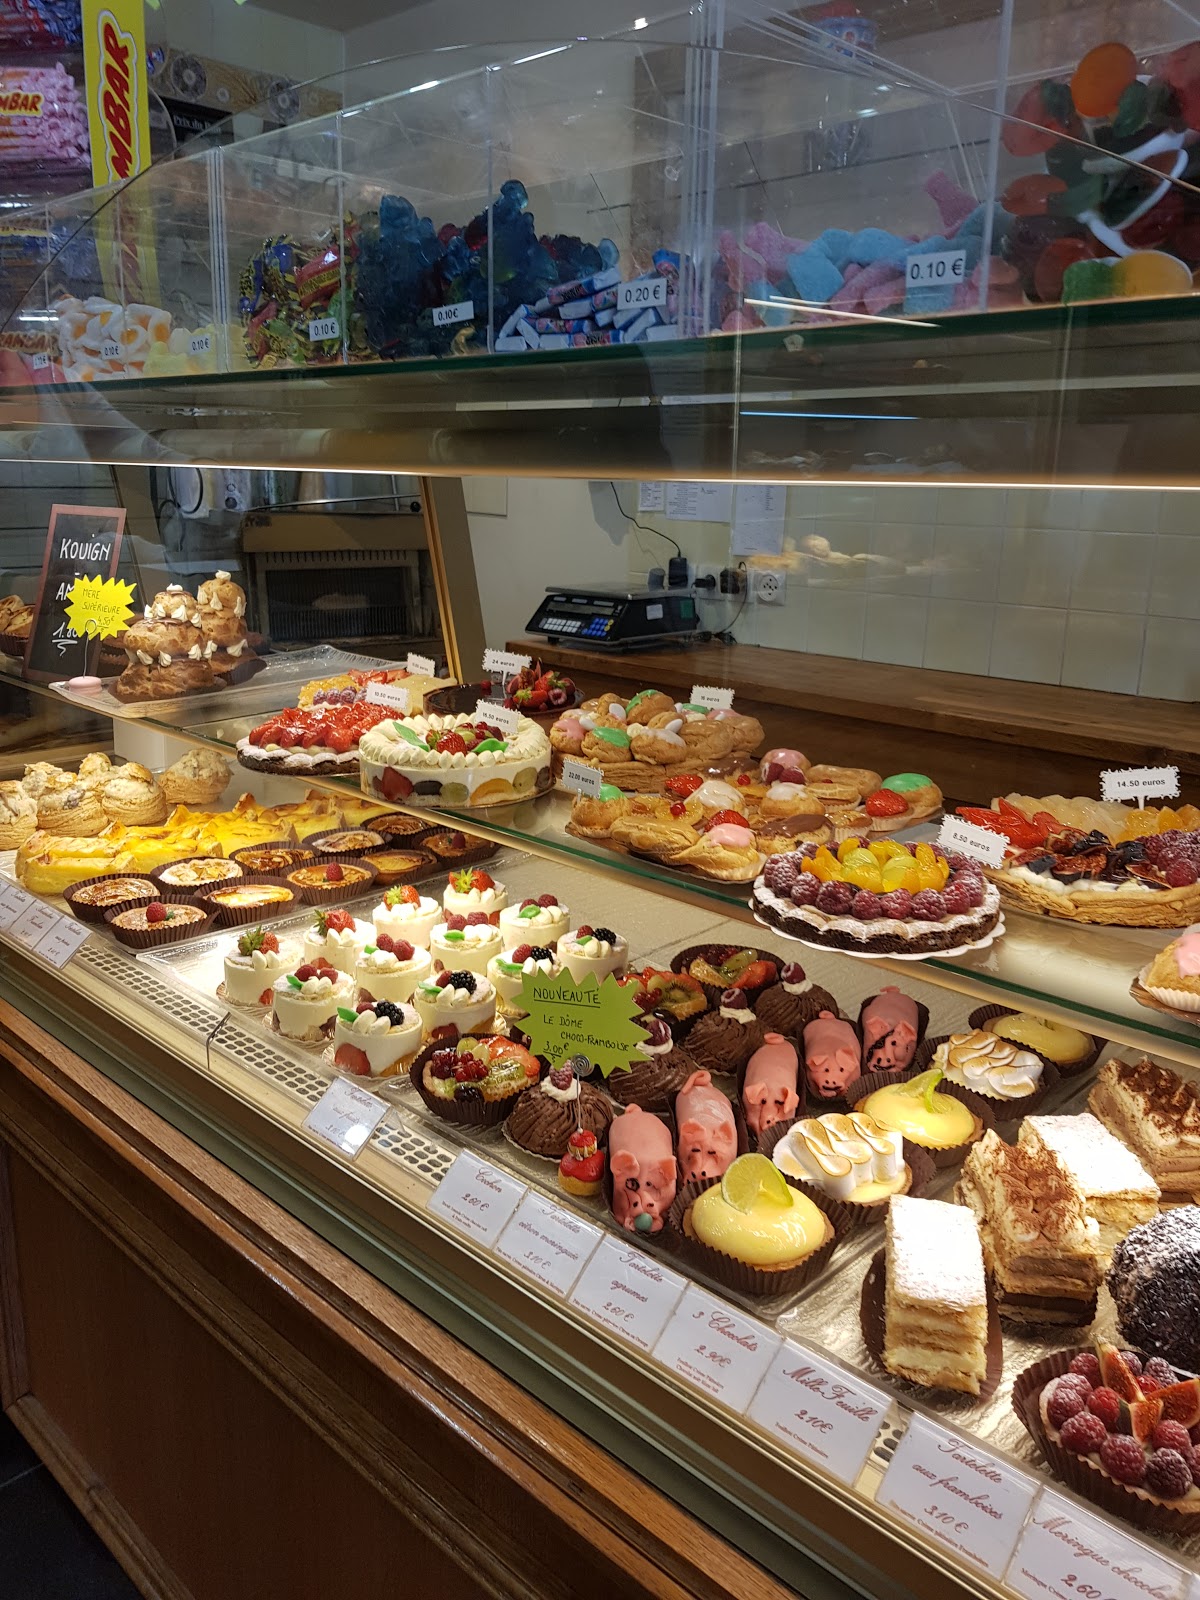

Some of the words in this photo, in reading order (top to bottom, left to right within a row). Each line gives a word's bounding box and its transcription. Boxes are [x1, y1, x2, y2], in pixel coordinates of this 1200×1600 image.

[910, 261, 945, 279] 0.10
[952, 258, 963, 276] €
[625, 287, 649, 303] 0.20
[653, 285, 661, 300] €
[314, 323, 328, 336] 0.10
[330, 322, 336, 334] €
[60, 534, 111, 561] KOUIGN
[1117, 780, 1139, 788] 14.50
[952, 832, 968, 843] 8.50
[969, 840, 991, 852] euros
[533, 986, 601, 1004] NOUVEAUTÉ
[543, 1014, 554, 1025] LE
[560, 1014, 584, 1029] DÔME
[518, 1220, 540, 1237] citron
[692, 1311, 704, 1319] 3
[708, 1311, 758, 1352] Chocolats
[937, 1438, 1002, 1484] Tartelette
[912, 1463, 937, 1480] aux
[929, 1476, 1003, 1520] framboises
[1032, 1516, 1110, 1566] Meringue
